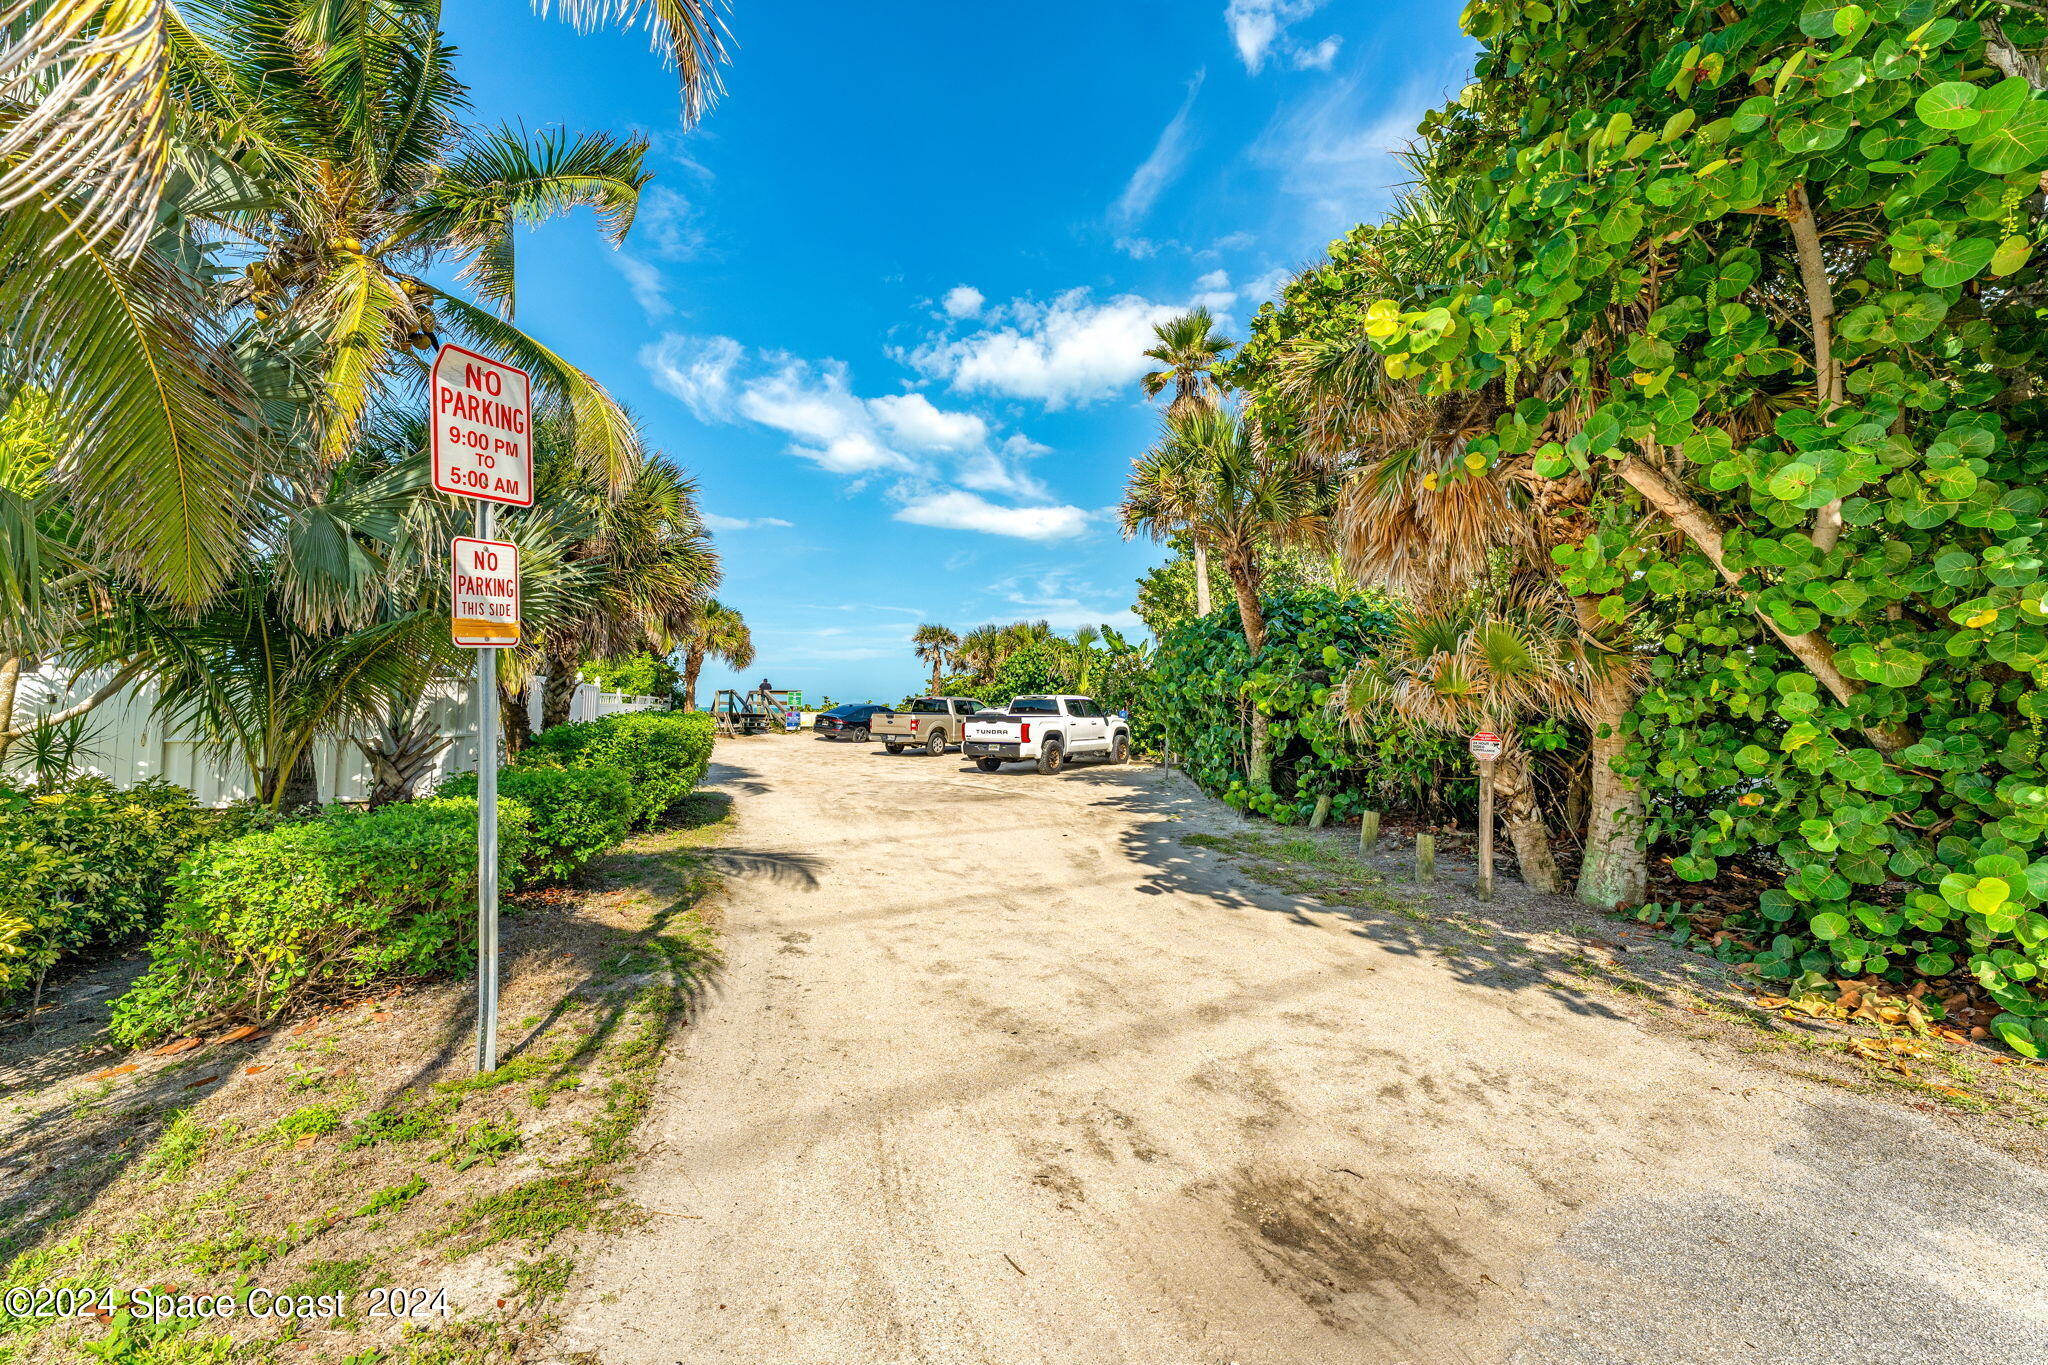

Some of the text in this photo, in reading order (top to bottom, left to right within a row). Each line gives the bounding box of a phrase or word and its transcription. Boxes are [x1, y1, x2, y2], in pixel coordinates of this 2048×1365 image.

[465, 363, 502, 397] NO
[441, 386, 524, 435] PARKING
[449, 426, 519, 459] 9:00 PM
[475, 453, 495, 469] TO
[450, 467, 519, 496] 5:00 AM
[474, 550, 498, 571] NO
[458, 575, 514, 598] PARKING
[462, 601, 511, 617] THIS SIDE
